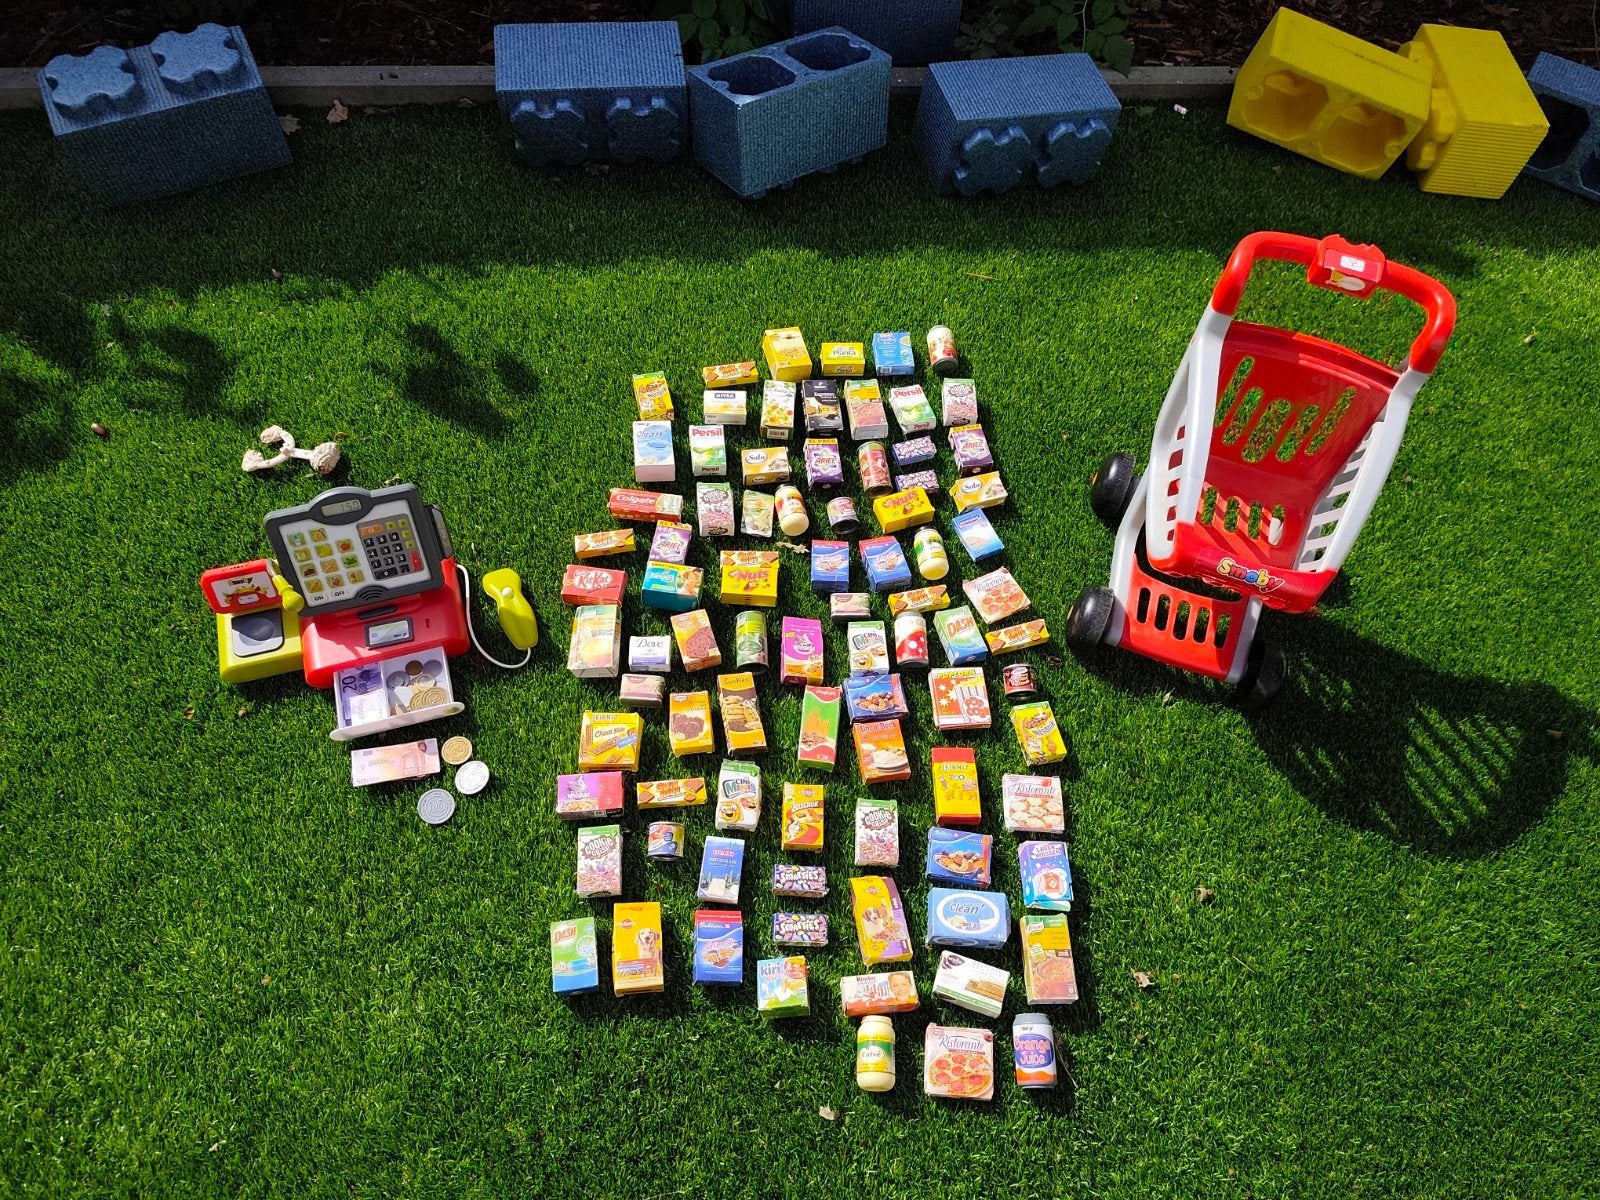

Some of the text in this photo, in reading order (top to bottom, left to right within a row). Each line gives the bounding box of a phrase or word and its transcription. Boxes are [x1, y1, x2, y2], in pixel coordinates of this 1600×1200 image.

[893, 386, 922, 398] Persil
[692, 428, 722, 437] Persil
[616, 494, 656, 505] Colgate
[657, 541, 681, 550] ARIEL
[1218, 558, 1286, 593] Smoby
[947, 616, 974, 638] DASH
[636, 638, 664, 648] Dove
[937, 670, 976, 678] POPCORN
[342, 676, 356, 693] 20
[593, 714, 618, 722] LEIBNIZ
[942, 764, 968, 772] LEIBNIZ
[429, 800, 443, 812] 10
[584, 838, 613, 855] COOKIE
[950, 902, 978, 914] Clean
[780, 919, 820, 934] SMARTIES
[554, 926, 576, 944] DASH
[760, 962, 780, 976] kiri
[939, 1035, 984, 1050] Ristorante
[1014, 1036, 1050, 1054] Orange
[1020, 1050, 1046, 1064] Juice
